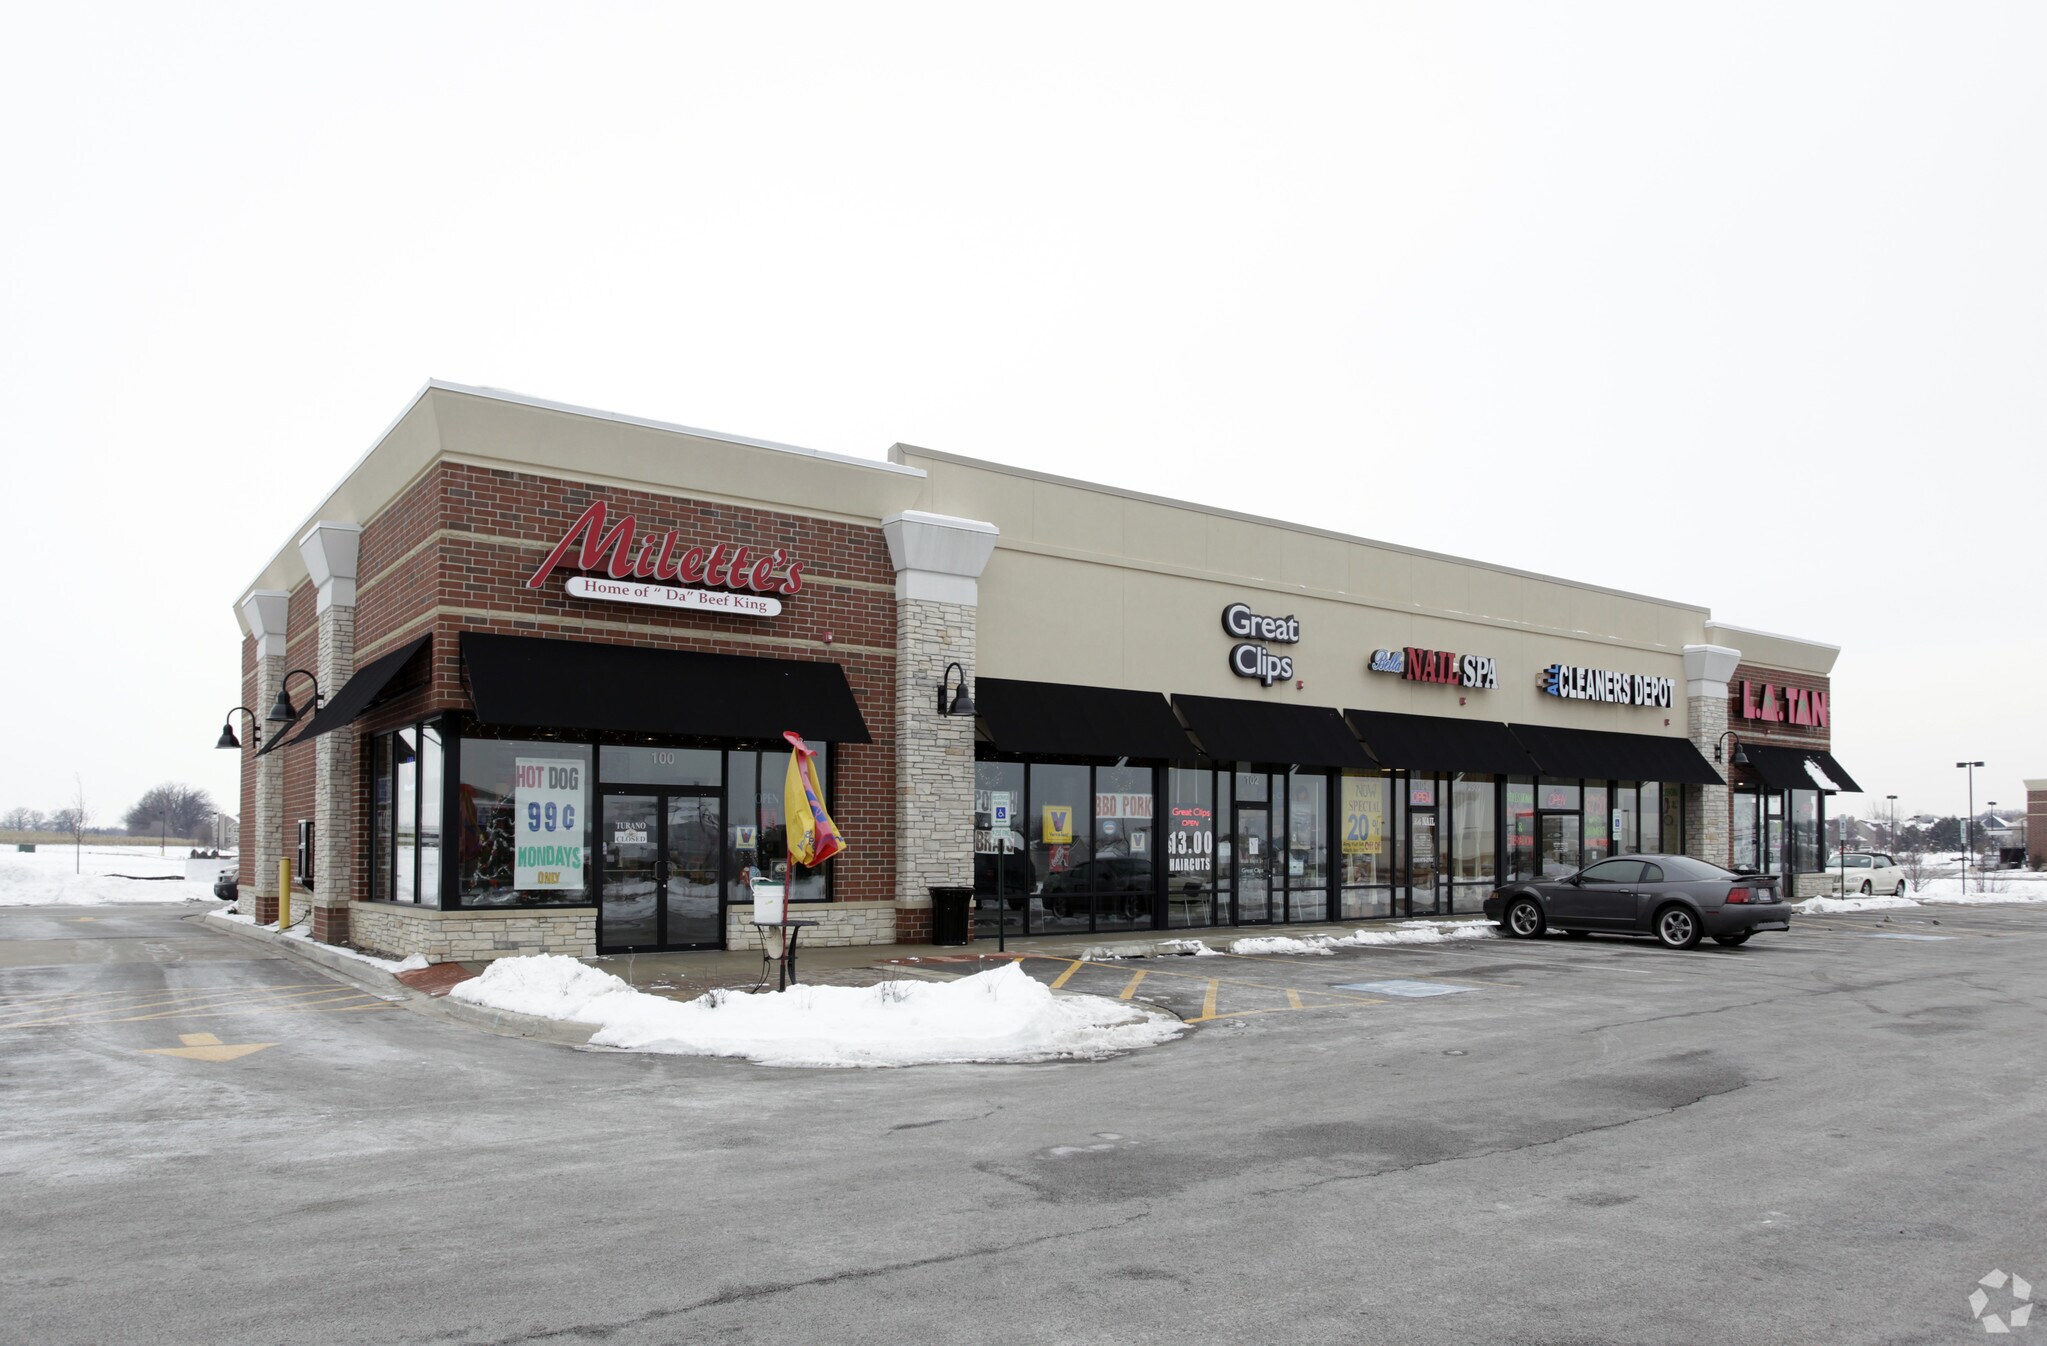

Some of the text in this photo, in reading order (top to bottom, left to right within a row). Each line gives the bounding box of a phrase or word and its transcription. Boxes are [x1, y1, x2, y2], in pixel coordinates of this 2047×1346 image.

[526, 500, 804, 595] Milette's
[584, 580, 629, 596] Home
[634, 586, 651, 598] of
[699, 592, 729, 606] Beef
[734, 597, 767, 613] King
[1227, 603, 1299, 643] Great
[1234, 644, 1293, 685] Clips
[1371, 647, 1499, 689] Bella NAIL SPA
[1546, 664, 1676, 709] ALL CLEANERS DEPOT
[1785, 687, 1828, 728] TAN
[652, 752, 675, 765] 100
[516, 765, 579, 790] HOT DOG
[1245, 776, 1260, 785] 102
[1122, 795, 1152, 816] PORK
[1172, 808, 1211, 817] Great Clips
[1348, 800, 1381, 813] SPECIAL
[616, 822, 646, 830] TURANO
[1347, 814, 1370, 841] 20
[616, 835, 646, 844] CLOSED
[1168, 831, 1213, 854] $13.00
[517, 846, 581, 869] MONDAYS
[1169, 858, 1211, 871] HAIRCUTS
[538, 871, 560, 885] ONLY
